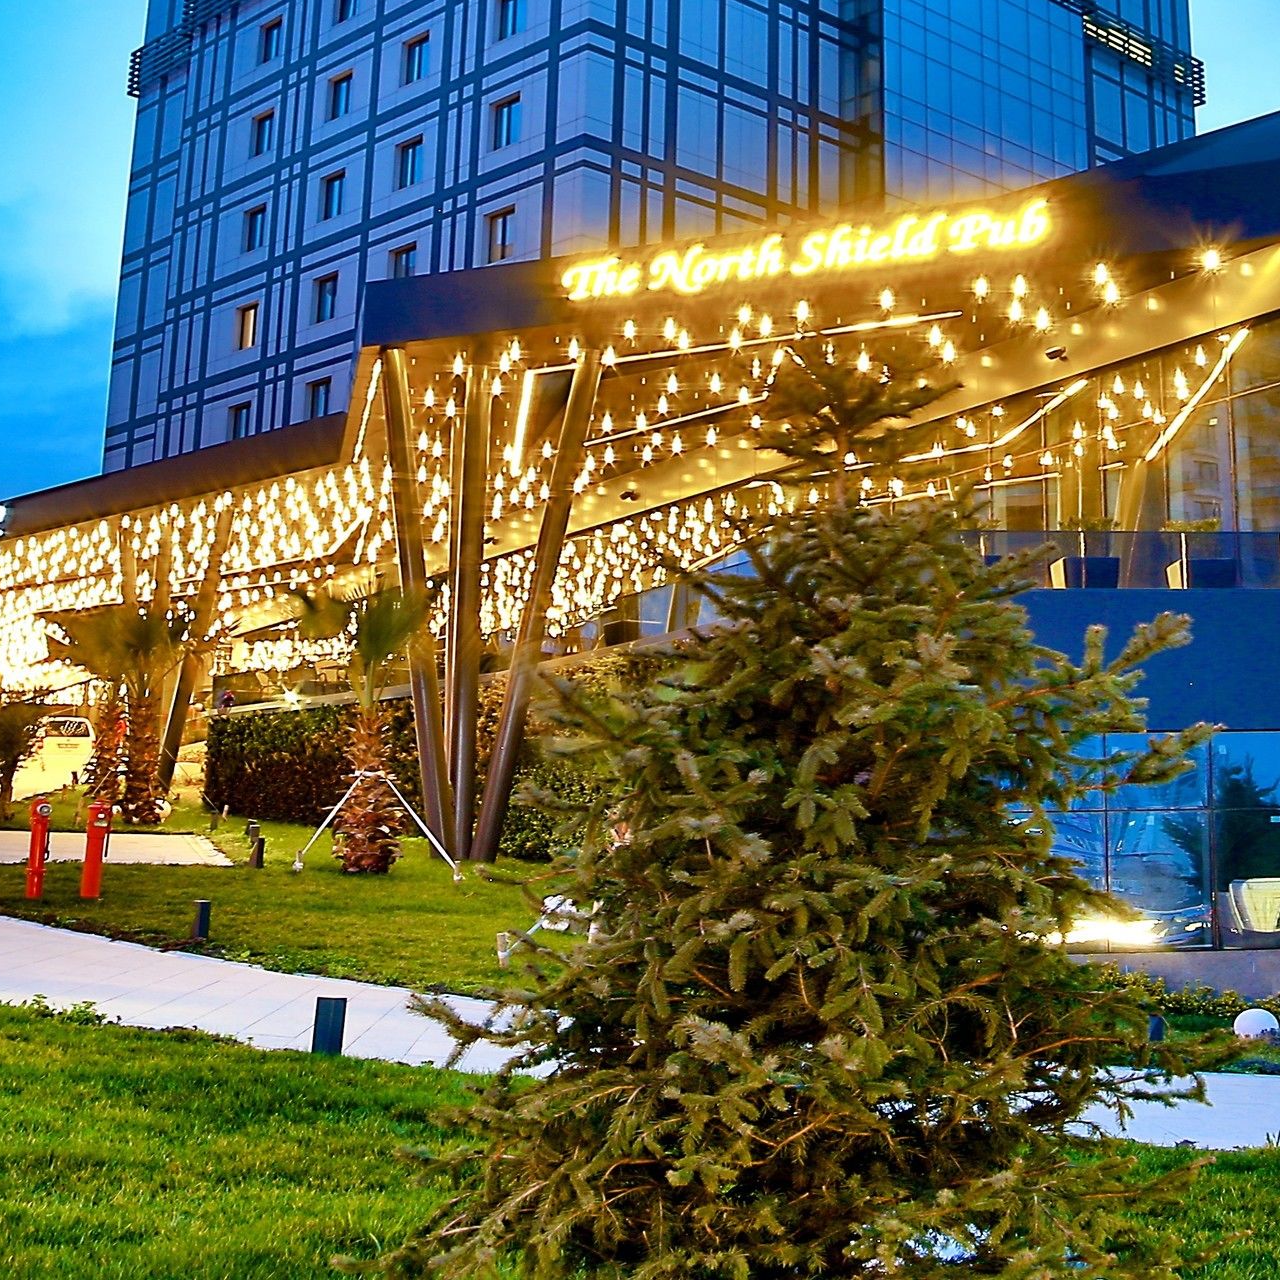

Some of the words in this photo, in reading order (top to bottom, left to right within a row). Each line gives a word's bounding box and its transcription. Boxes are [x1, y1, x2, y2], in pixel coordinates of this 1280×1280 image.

[559, 255, 639, 301] The
[647, 233, 784, 295] North
[790, 212, 948, 277] Shield
[948, 199, 1052, 254] Pub
